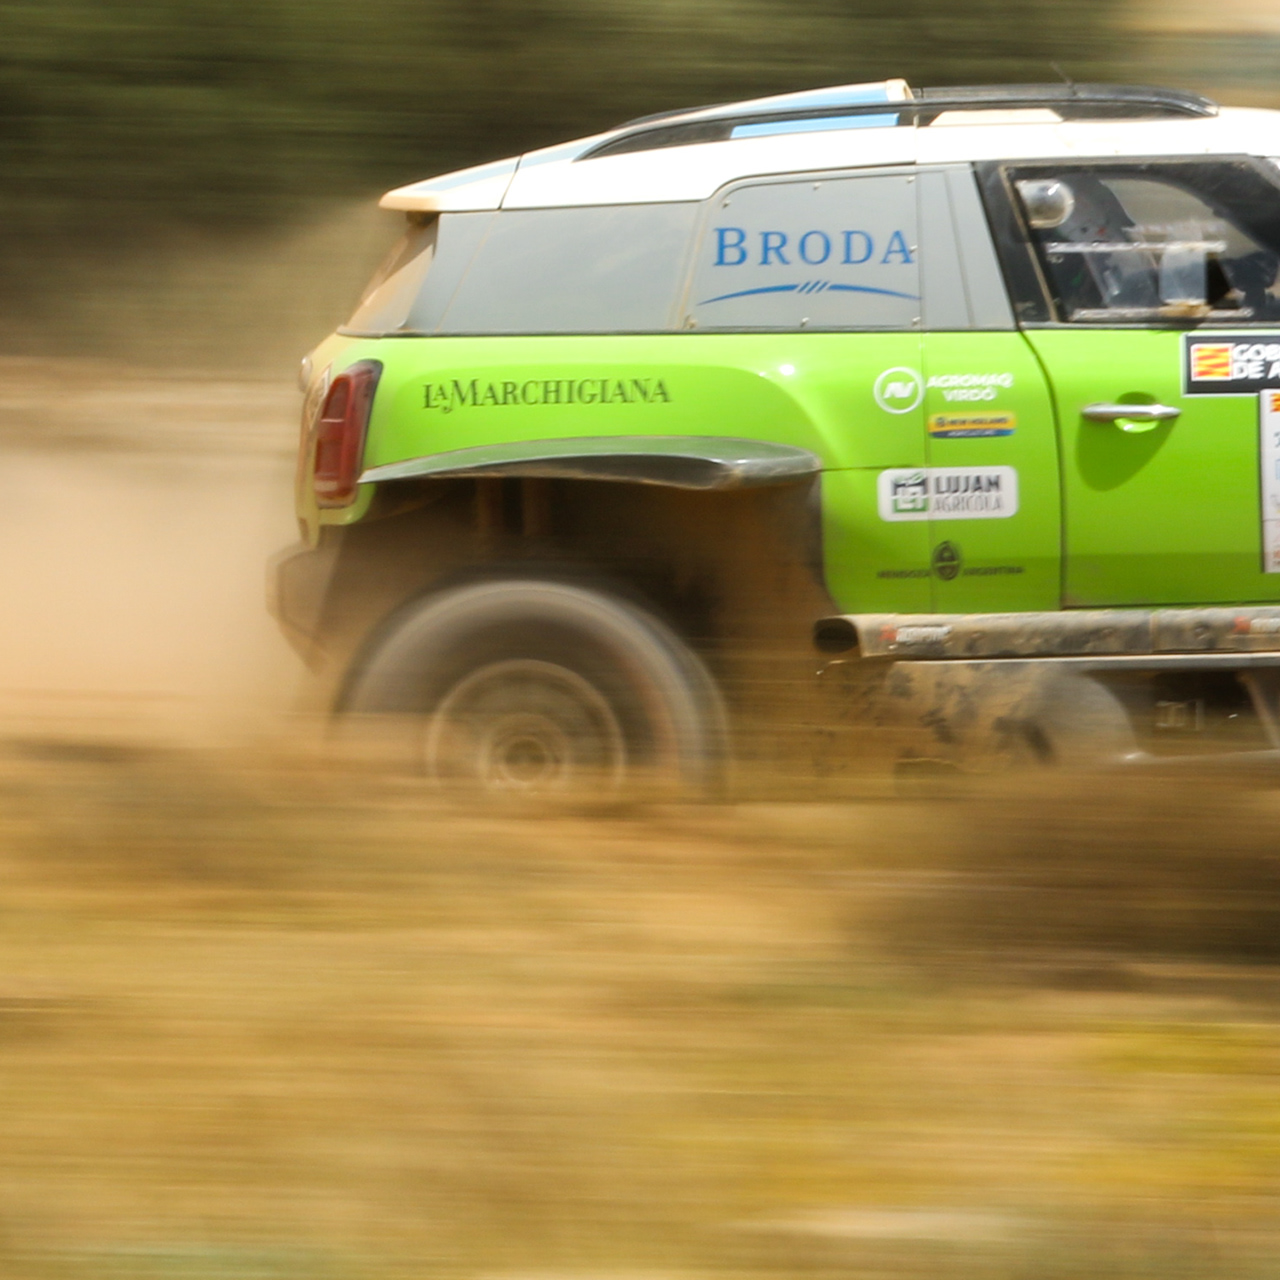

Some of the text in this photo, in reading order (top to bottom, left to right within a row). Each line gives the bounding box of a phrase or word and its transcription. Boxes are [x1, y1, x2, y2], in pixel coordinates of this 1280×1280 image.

[713, 227, 916, 267] BRODA
[1233, 361, 1265, 379] DE
[926, 372, 1014, 389] AGROMAQ
[934, 474, 1001, 495] LUJAN
